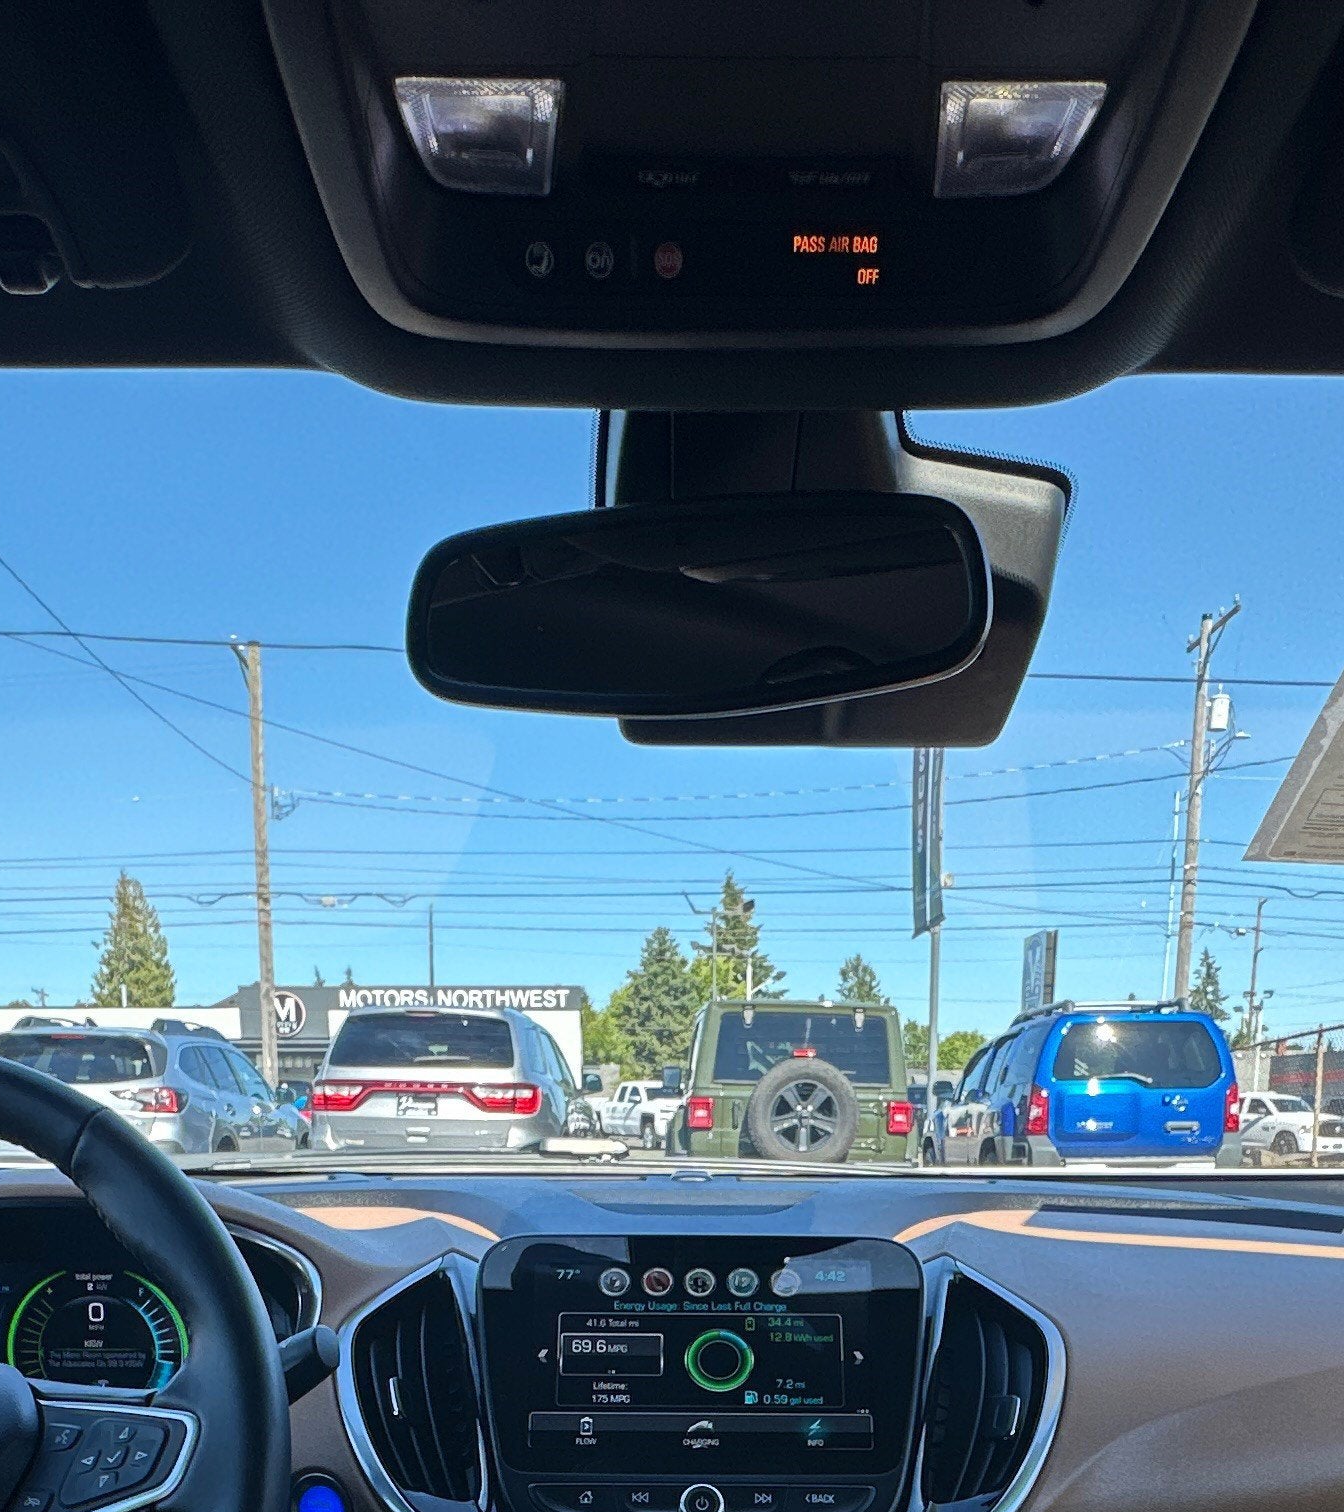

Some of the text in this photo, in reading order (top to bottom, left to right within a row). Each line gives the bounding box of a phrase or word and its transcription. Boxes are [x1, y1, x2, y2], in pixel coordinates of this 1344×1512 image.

[792, 235, 879, 254] PASS AIR BAG
[857, 268, 880, 286] OFF
[338, 989, 571, 1009] MOTORS NORTHWEST
[814, 1270, 848, 1283] 4:42
[88, 1302, 104, 1322] 0
[613, 1301, 645, 1312] Energy
[683, 1301, 709, 1311] Since
[711, 1301, 732, 1312] Last
[734, 1301, 752, 1312] Full
[753, 1302, 787, 1313] Charge
[608, 1318, 628, 1328] Total
[628, 1319, 640, 1328] mi
[767, 1317, 792, 1327] 34.4
[813, 1333, 834, 1343] used
[571, 1339, 628, 1354] 69.6 MPG
[592, 1381, 628, 1390] Lifetime:
[775, 1379, 806, 1389] 7.2 mi
[591, 1394, 631, 1403] 175 MPG
[803, 1396, 824, 1405] used
[575, 1438, 597, 1446] FLOW
[811, 1494, 835, 1504] BACK
